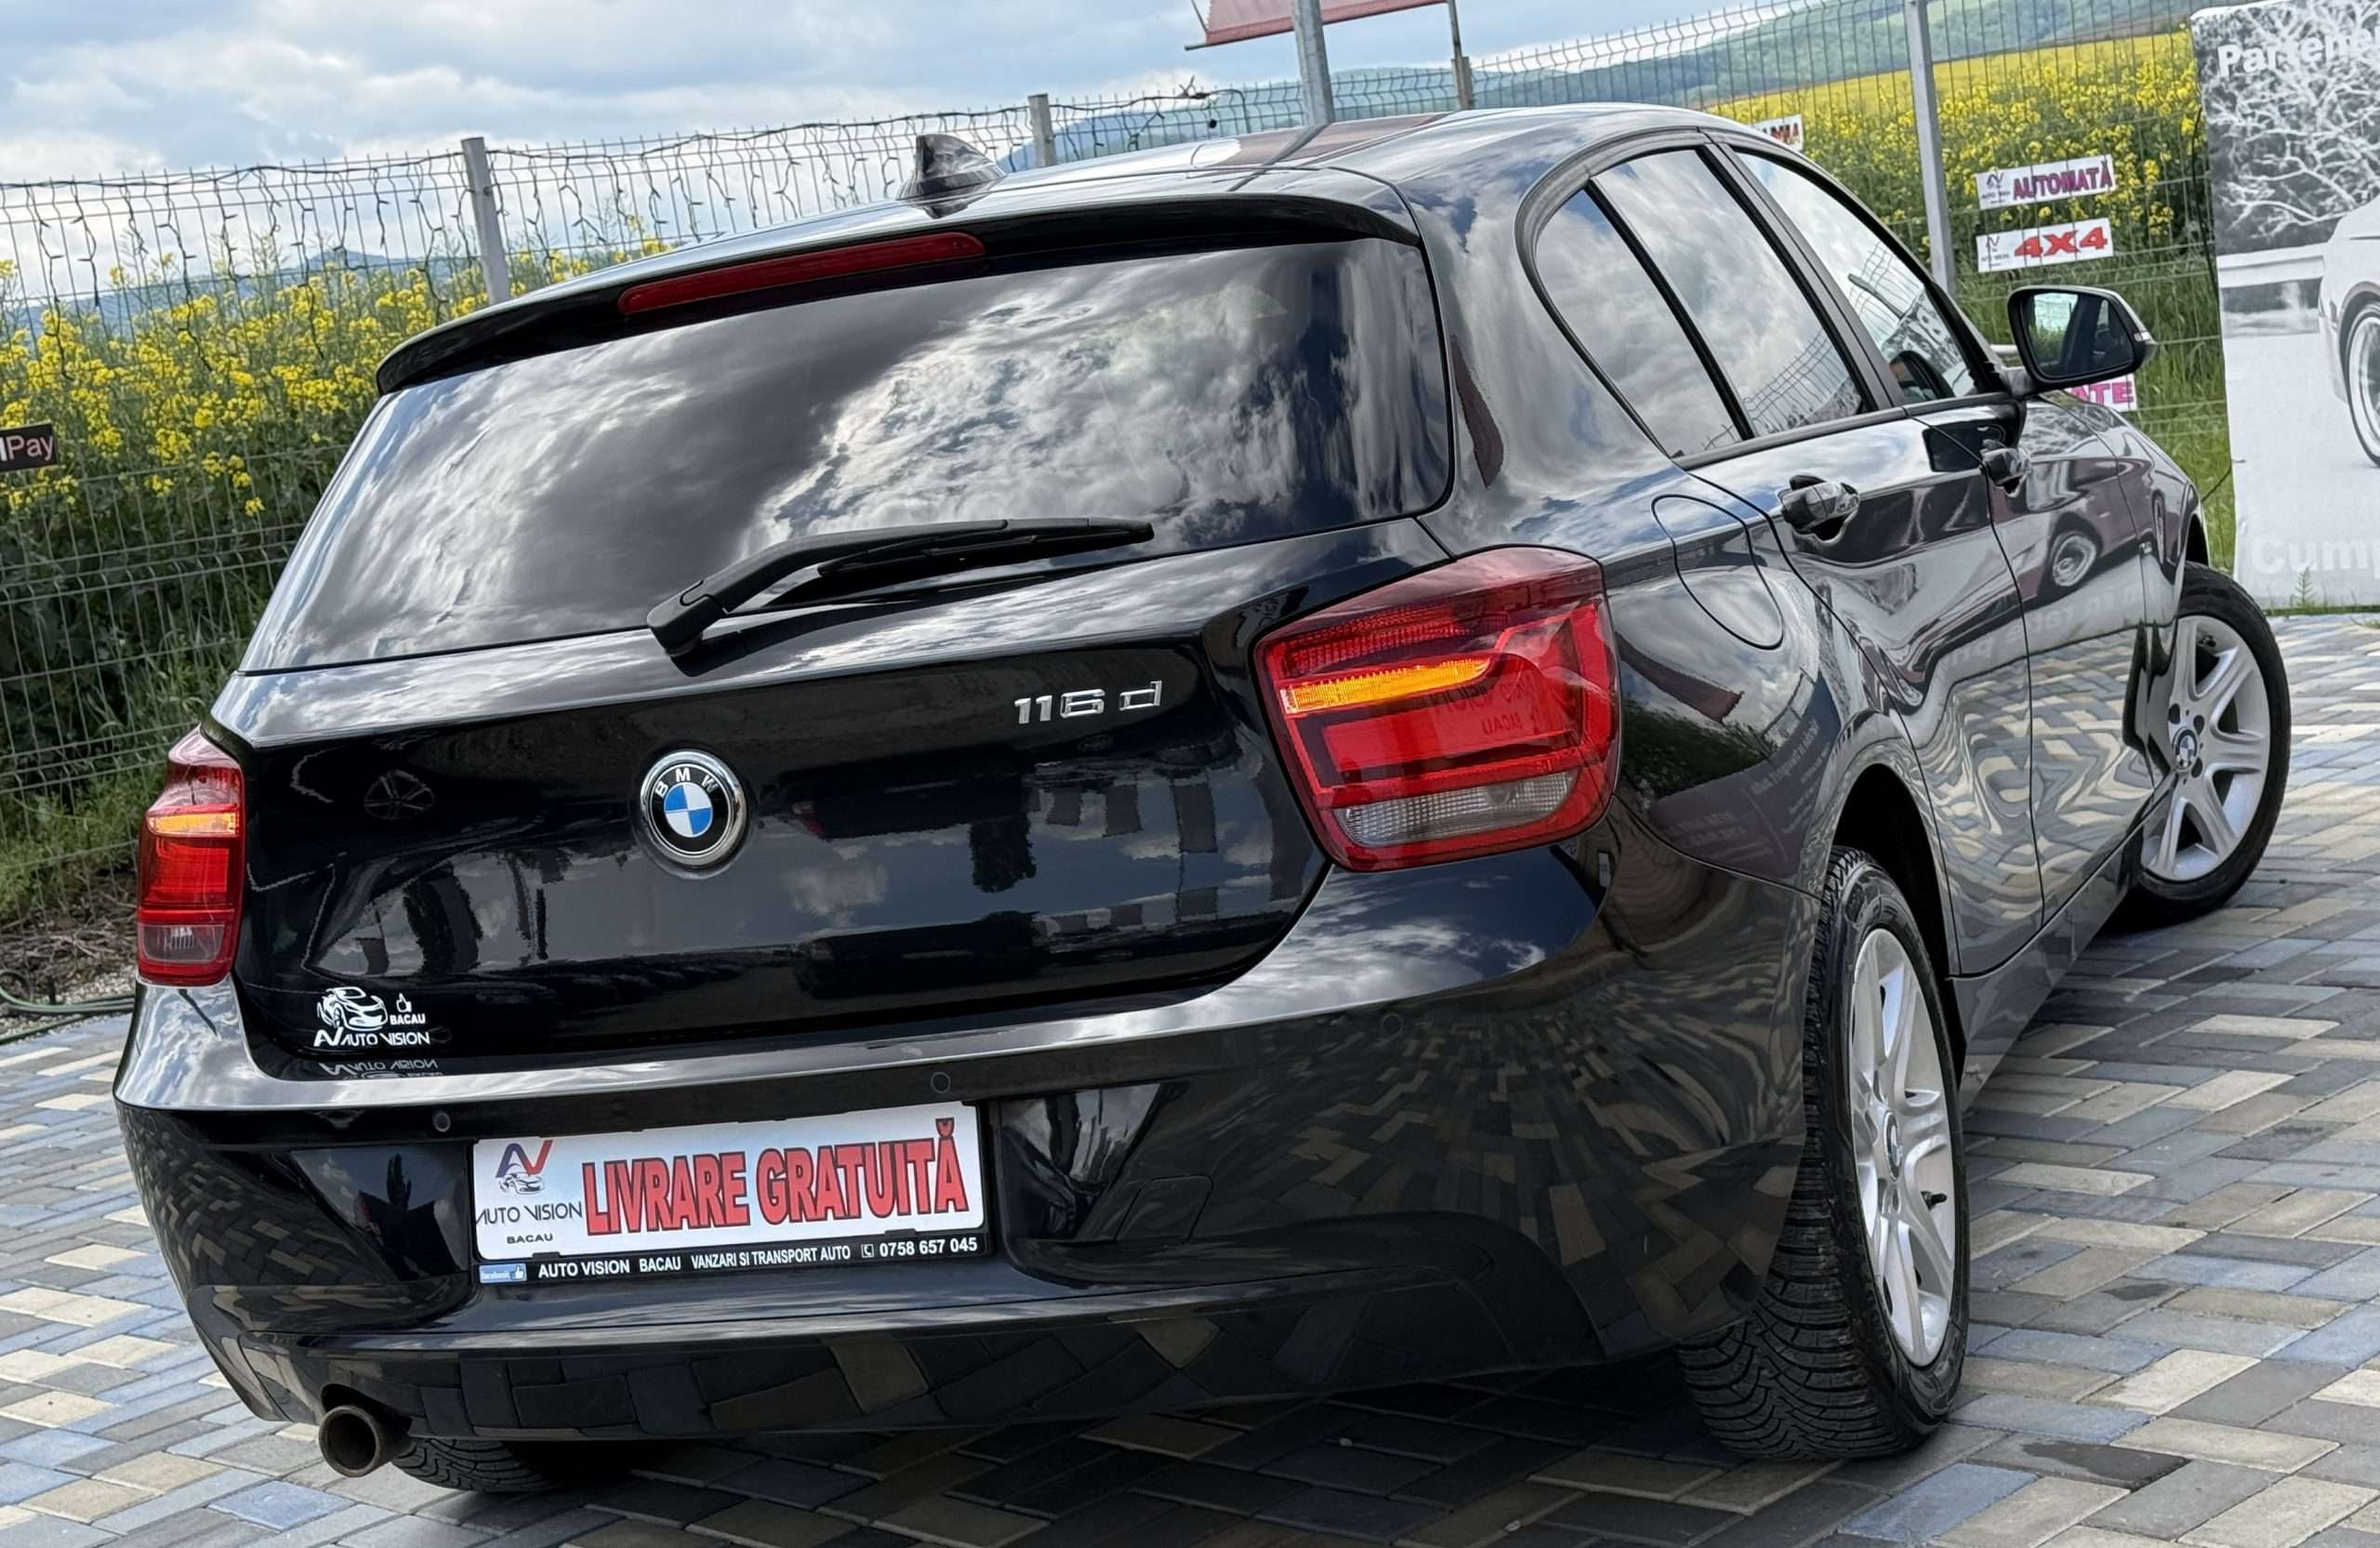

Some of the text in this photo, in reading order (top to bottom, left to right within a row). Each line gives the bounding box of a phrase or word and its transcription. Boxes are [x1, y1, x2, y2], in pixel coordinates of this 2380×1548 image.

[2252, 536, 2380, 580] Cum
[1014, 688, 1105, 724] 116
[654, 767, 719, 799] BMW
[390, 1013, 426, 1025] BACAU
[379, 1031, 430, 1047] VISION
[582, 1117, 970, 1237] LIVRARE GRATUITĂ
[475, 1200, 583, 1226] AUTO VISION
[507, 1233, 553, 1244] BACAU
[538, 1237, 978, 1279] AUTO VISION BACAU VANZARI SI TRANSPORT AUTO 0758 657 045
